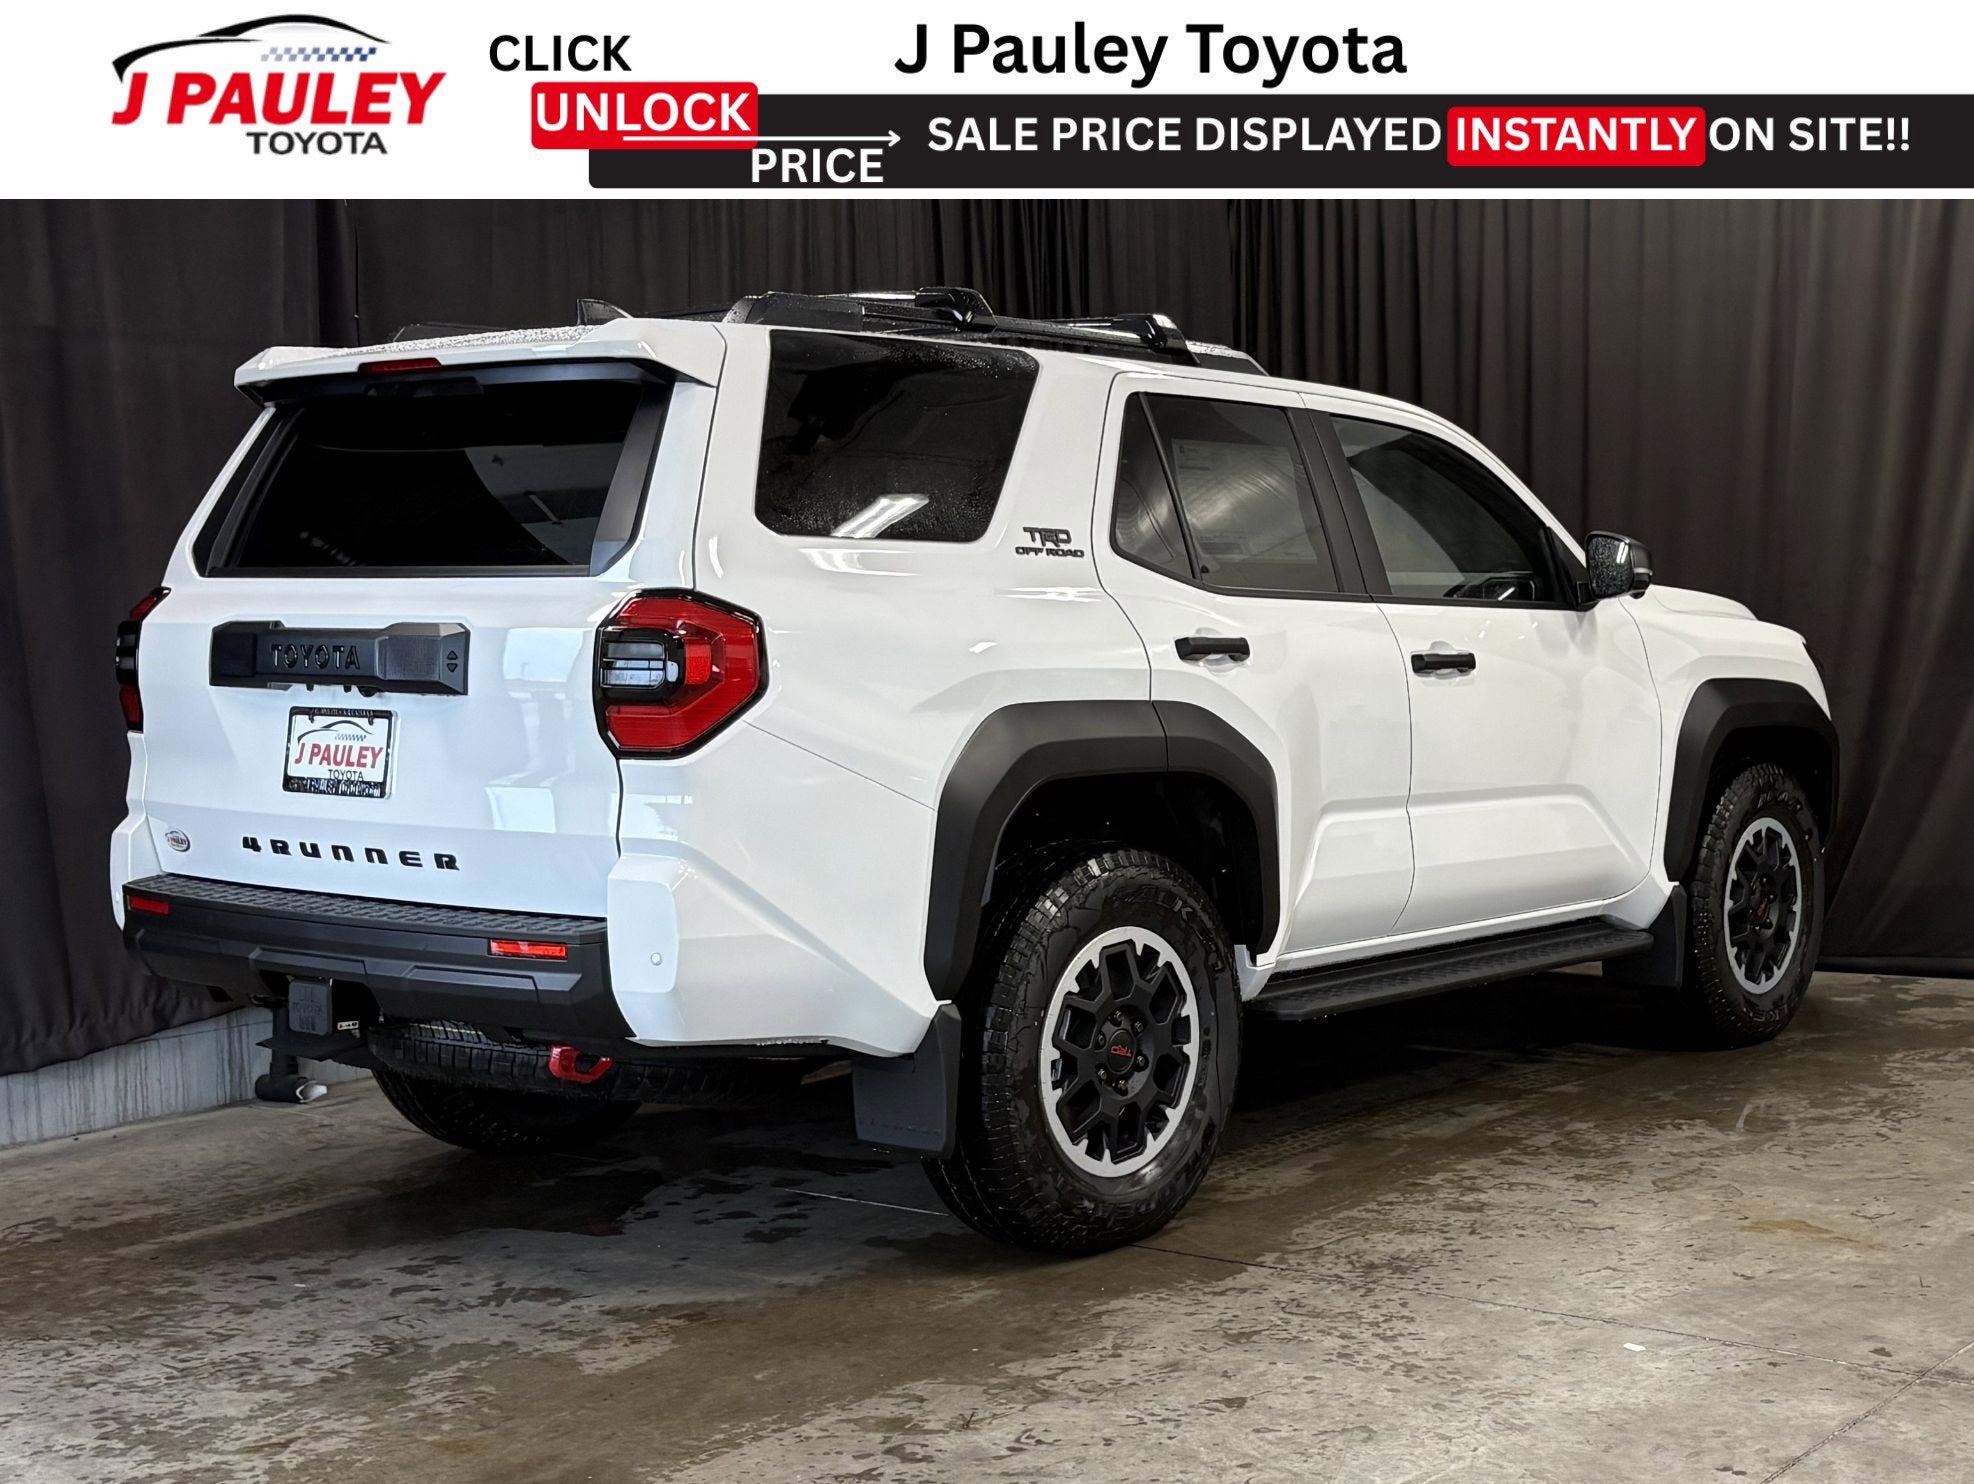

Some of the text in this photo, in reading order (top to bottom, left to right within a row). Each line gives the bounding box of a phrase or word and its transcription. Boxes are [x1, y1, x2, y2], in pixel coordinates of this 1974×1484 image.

[1022, 526, 1072, 547] TRD
[1015, 546, 1085, 558] OFF ROAD
[271, 644, 361, 670] TOYOTA
[294, 743, 384, 769] J PAULEY
[328, 769, 365, 781] TOYOTA
[242, 836, 460, 871] 4RUNNER
